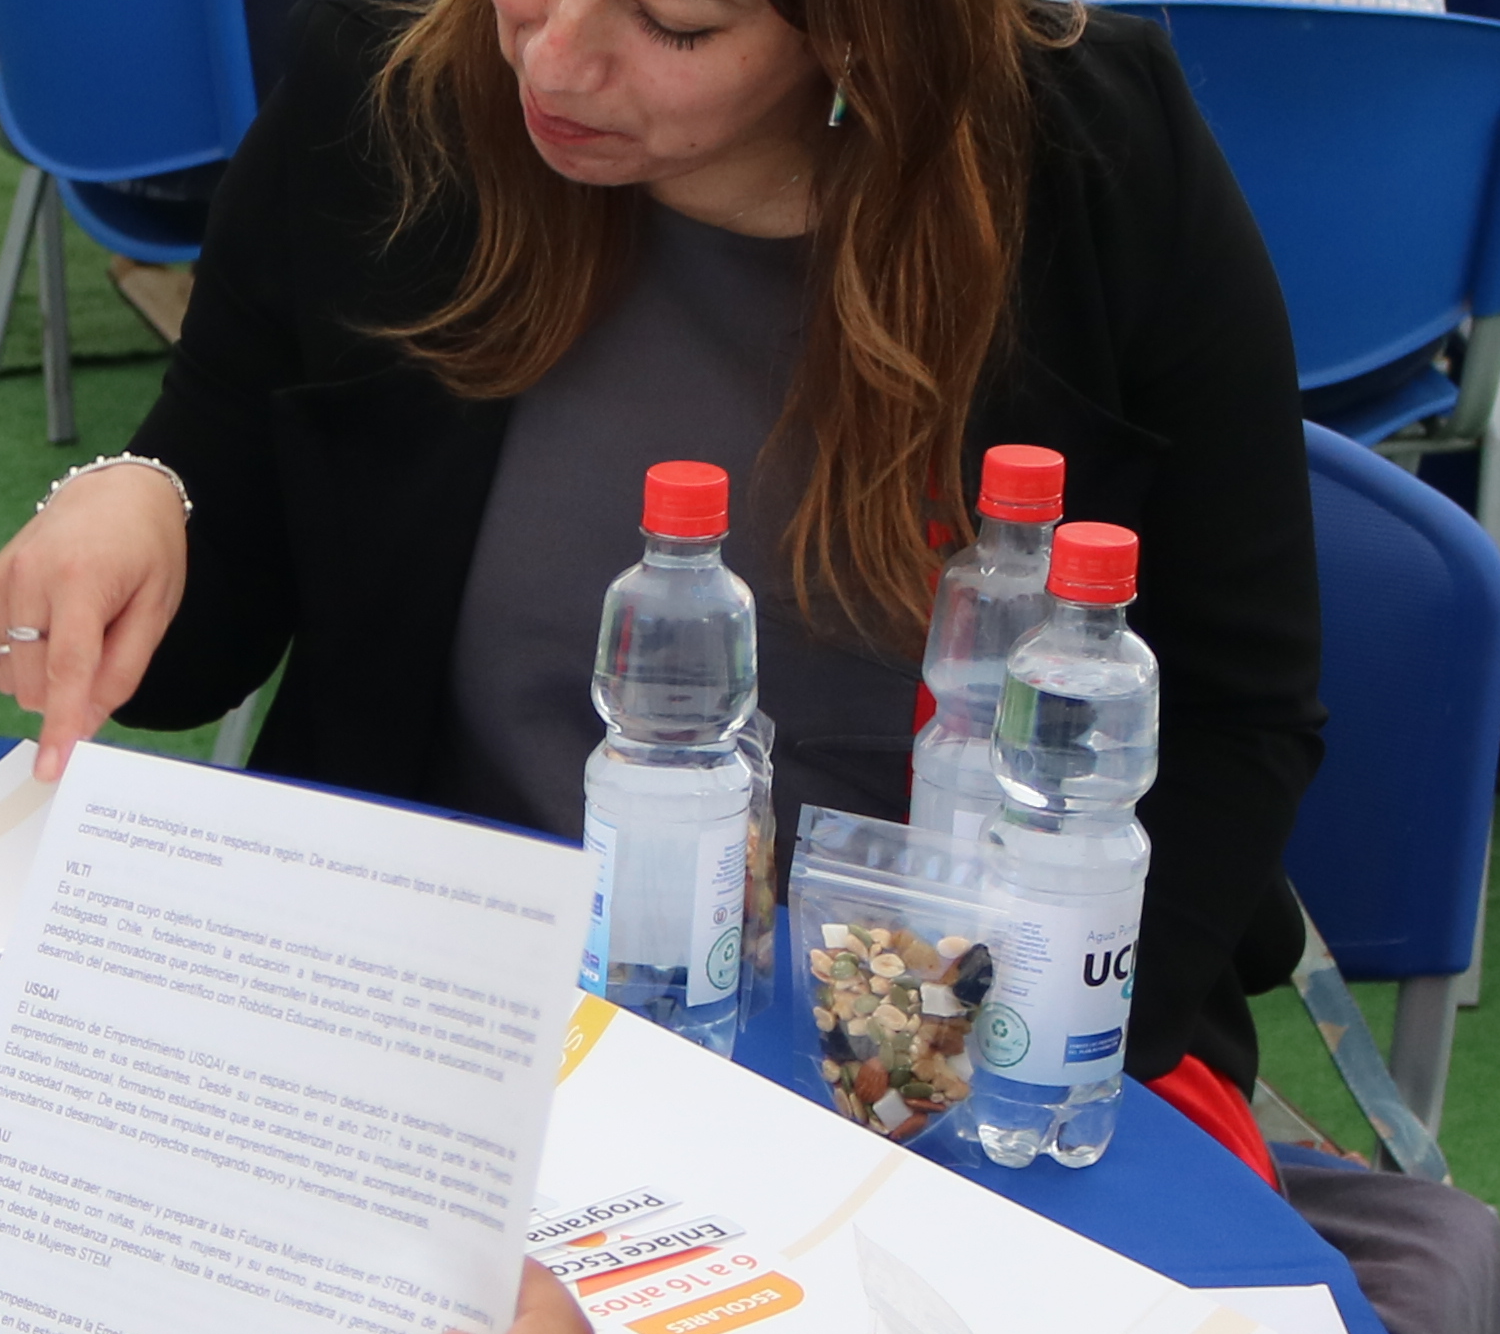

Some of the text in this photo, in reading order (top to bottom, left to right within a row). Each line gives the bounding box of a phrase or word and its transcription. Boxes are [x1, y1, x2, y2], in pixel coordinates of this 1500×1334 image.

[1086, 931, 1116, 944] Agua
[23, 982, 59, 1000] USQAI
[17, 1160, 38, 1175] que
[38, 1164, 70, 1185] busca
[104, 1188, 154, 1211] mantener
[153, 1204, 163, 1217] y
[162, 1207, 209, 1230] preparar
[526, 1192, 665, 1244] Programa
[21, 1228, 36, 1242] de
[36, 1232, 77, 1257] Mujeres
[547, 1222, 729, 1277] Enlace Esco
[588, 1254, 759, 1318] 6 a 16 años
[56, 1312, 82, 1328] para
[82, 1318, 94, 1332] la
